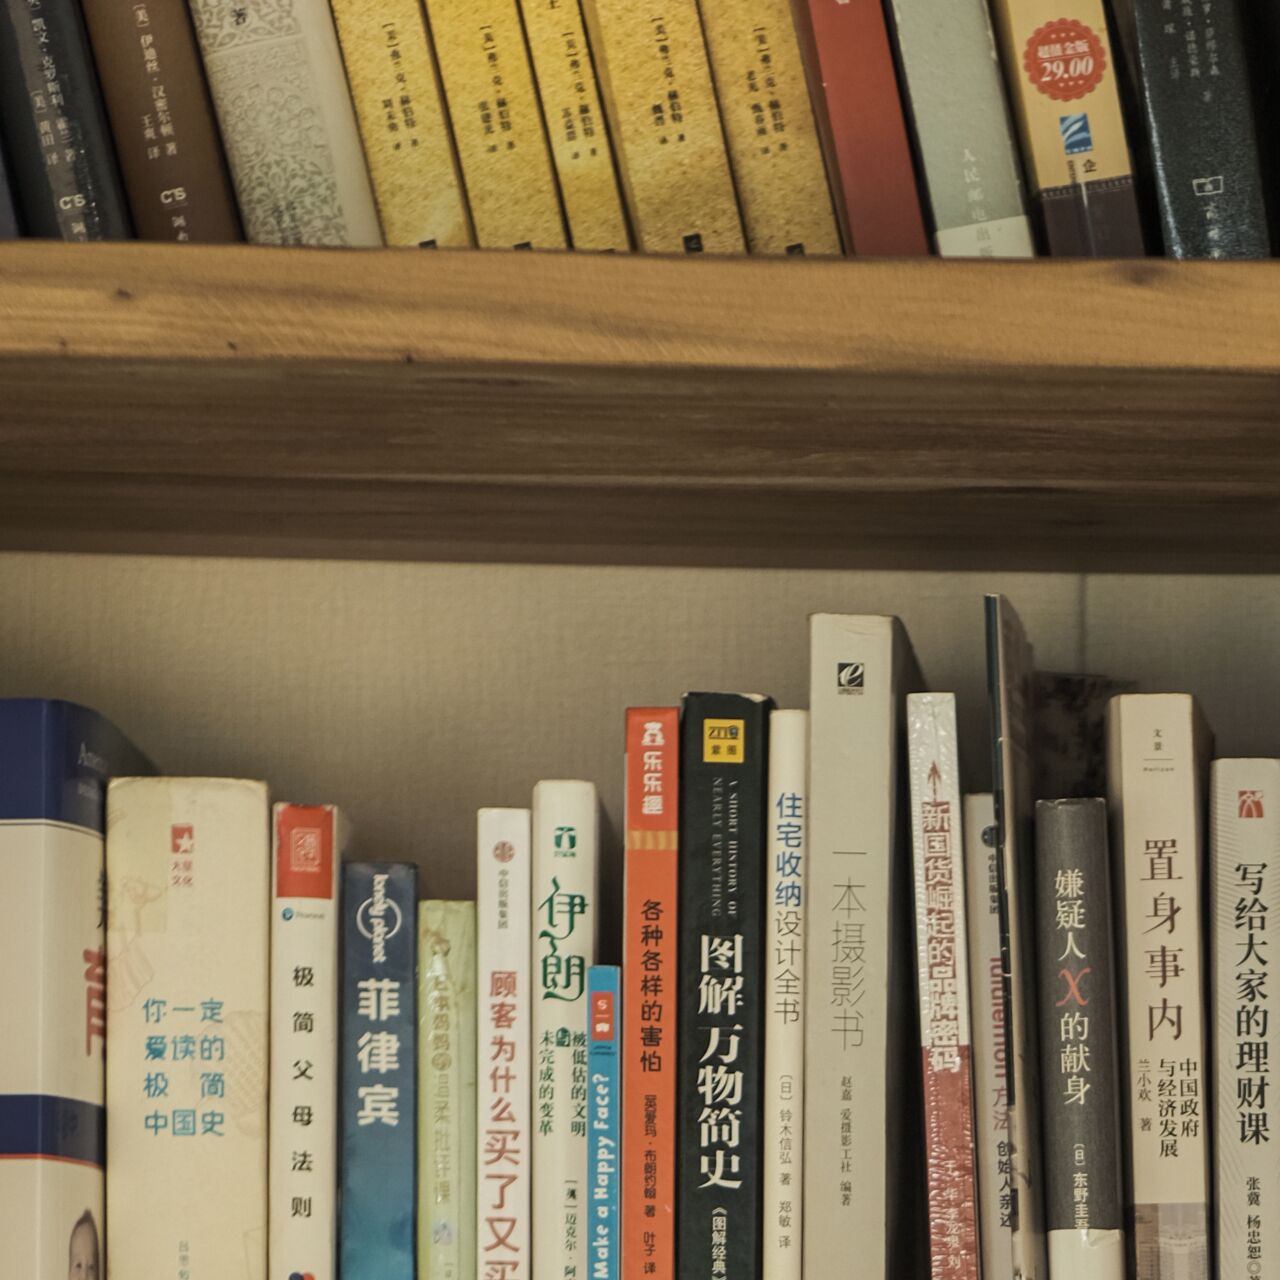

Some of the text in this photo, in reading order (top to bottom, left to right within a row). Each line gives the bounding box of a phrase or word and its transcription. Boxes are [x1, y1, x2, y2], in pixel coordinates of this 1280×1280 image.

[1040, 57, 1095, 82] 29.00
[538, 876, 589, 1002] 伊朗
[774, 790, 804, 1025] 住宅收纳设计全书
[1140, 838, 1186, 1042] 置身事内
[143, 998, 224, 1024] 你一定
[640, 899, 663, 1073] 各种各样的害怕
[1053, 869, 1092, 1106] 嫌疑人X的献身
[1233, 861, 1271, 1146] 写给大家的理财课
[144, 1034, 225, 1062] 爱读的
[291, 966, 314, 1218] 极简父母法则
[357, 978, 400, 1127] 菲律宾
[538, 1030, 554, 1137] 未完成的变革
[571, 1030, 587, 1137] 被低估的文明
[593, 1073, 610, 1130] Face?
[697, 934, 744, 1190] 图解万物简史
[1180, 1059, 1199, 1138] 中国政府
[144, 1108, 225, 1137] 中国史
[1157, 1059, 1179, 1159] 与经济发展
[593, 1136, 615, 1201] Happy
[597, 1205, 608, 1218] a
[593, 1221, 609, 1278] Make
